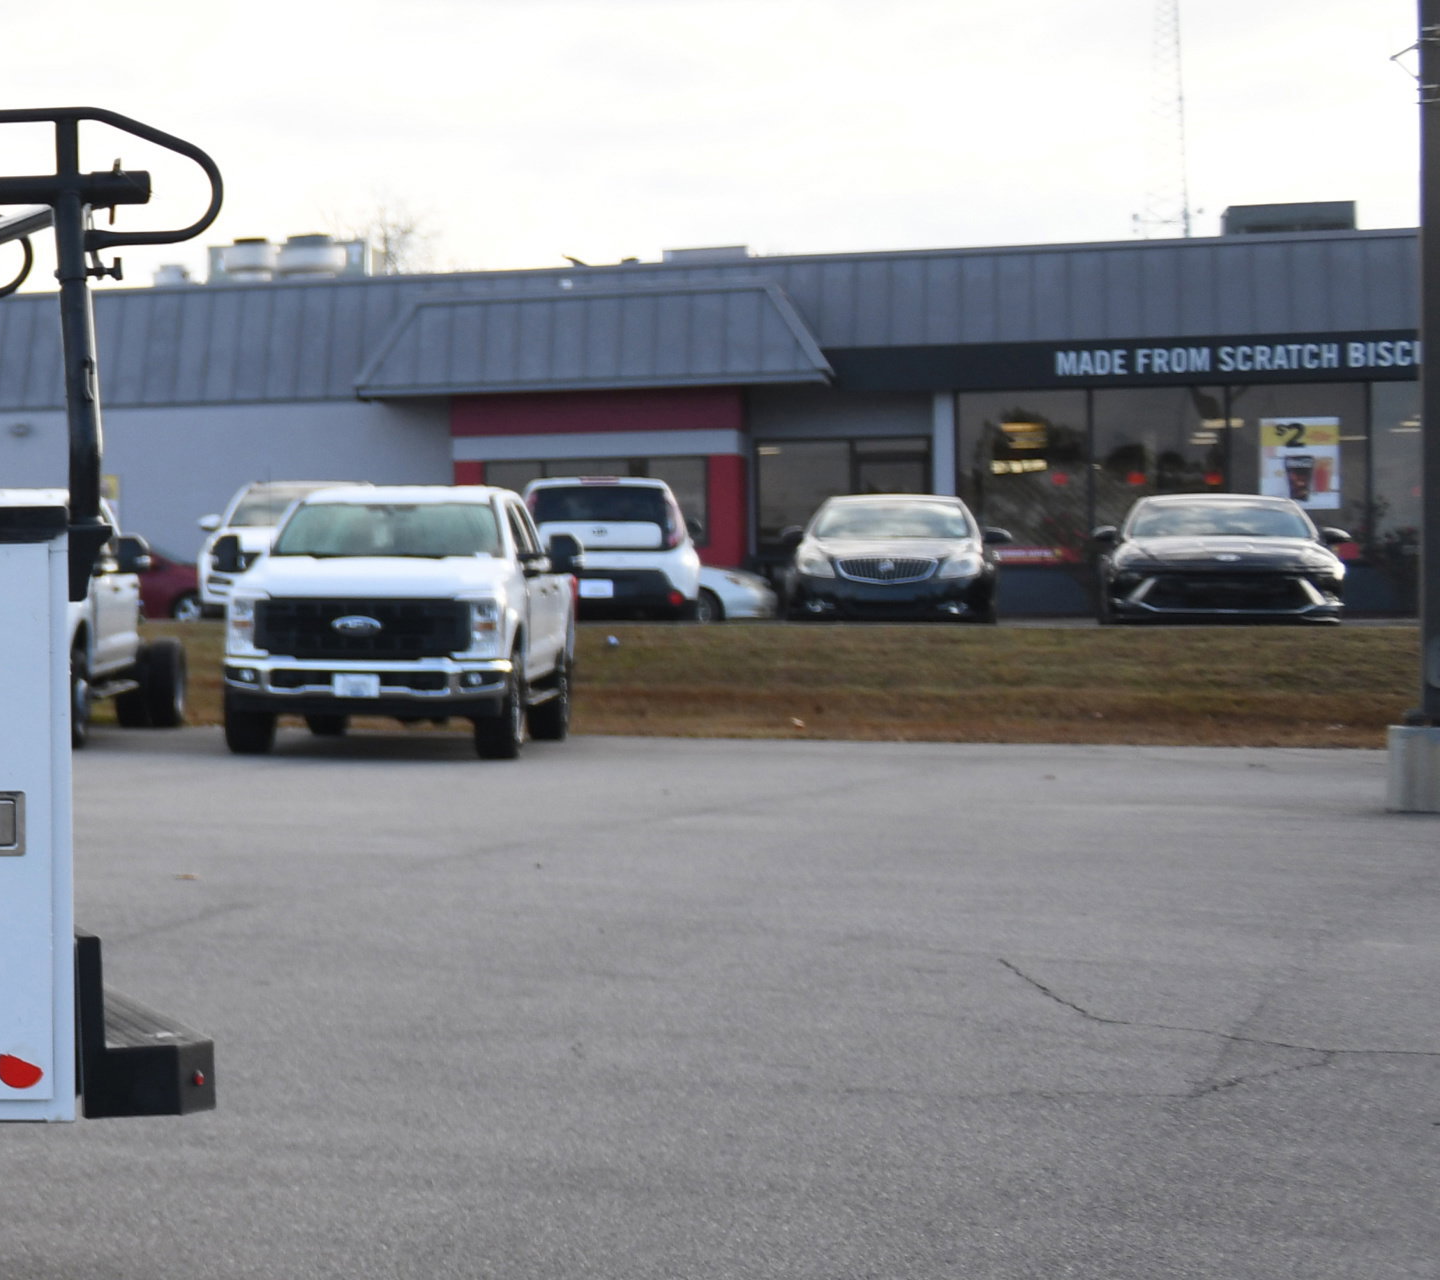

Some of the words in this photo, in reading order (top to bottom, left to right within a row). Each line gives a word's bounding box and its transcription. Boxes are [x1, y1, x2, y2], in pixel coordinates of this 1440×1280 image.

[1054, 349, 1128, 376] MADE
[1135, 346, 1211, 374] FROM
[1218, 343, 1339, 371] SCRATCH
